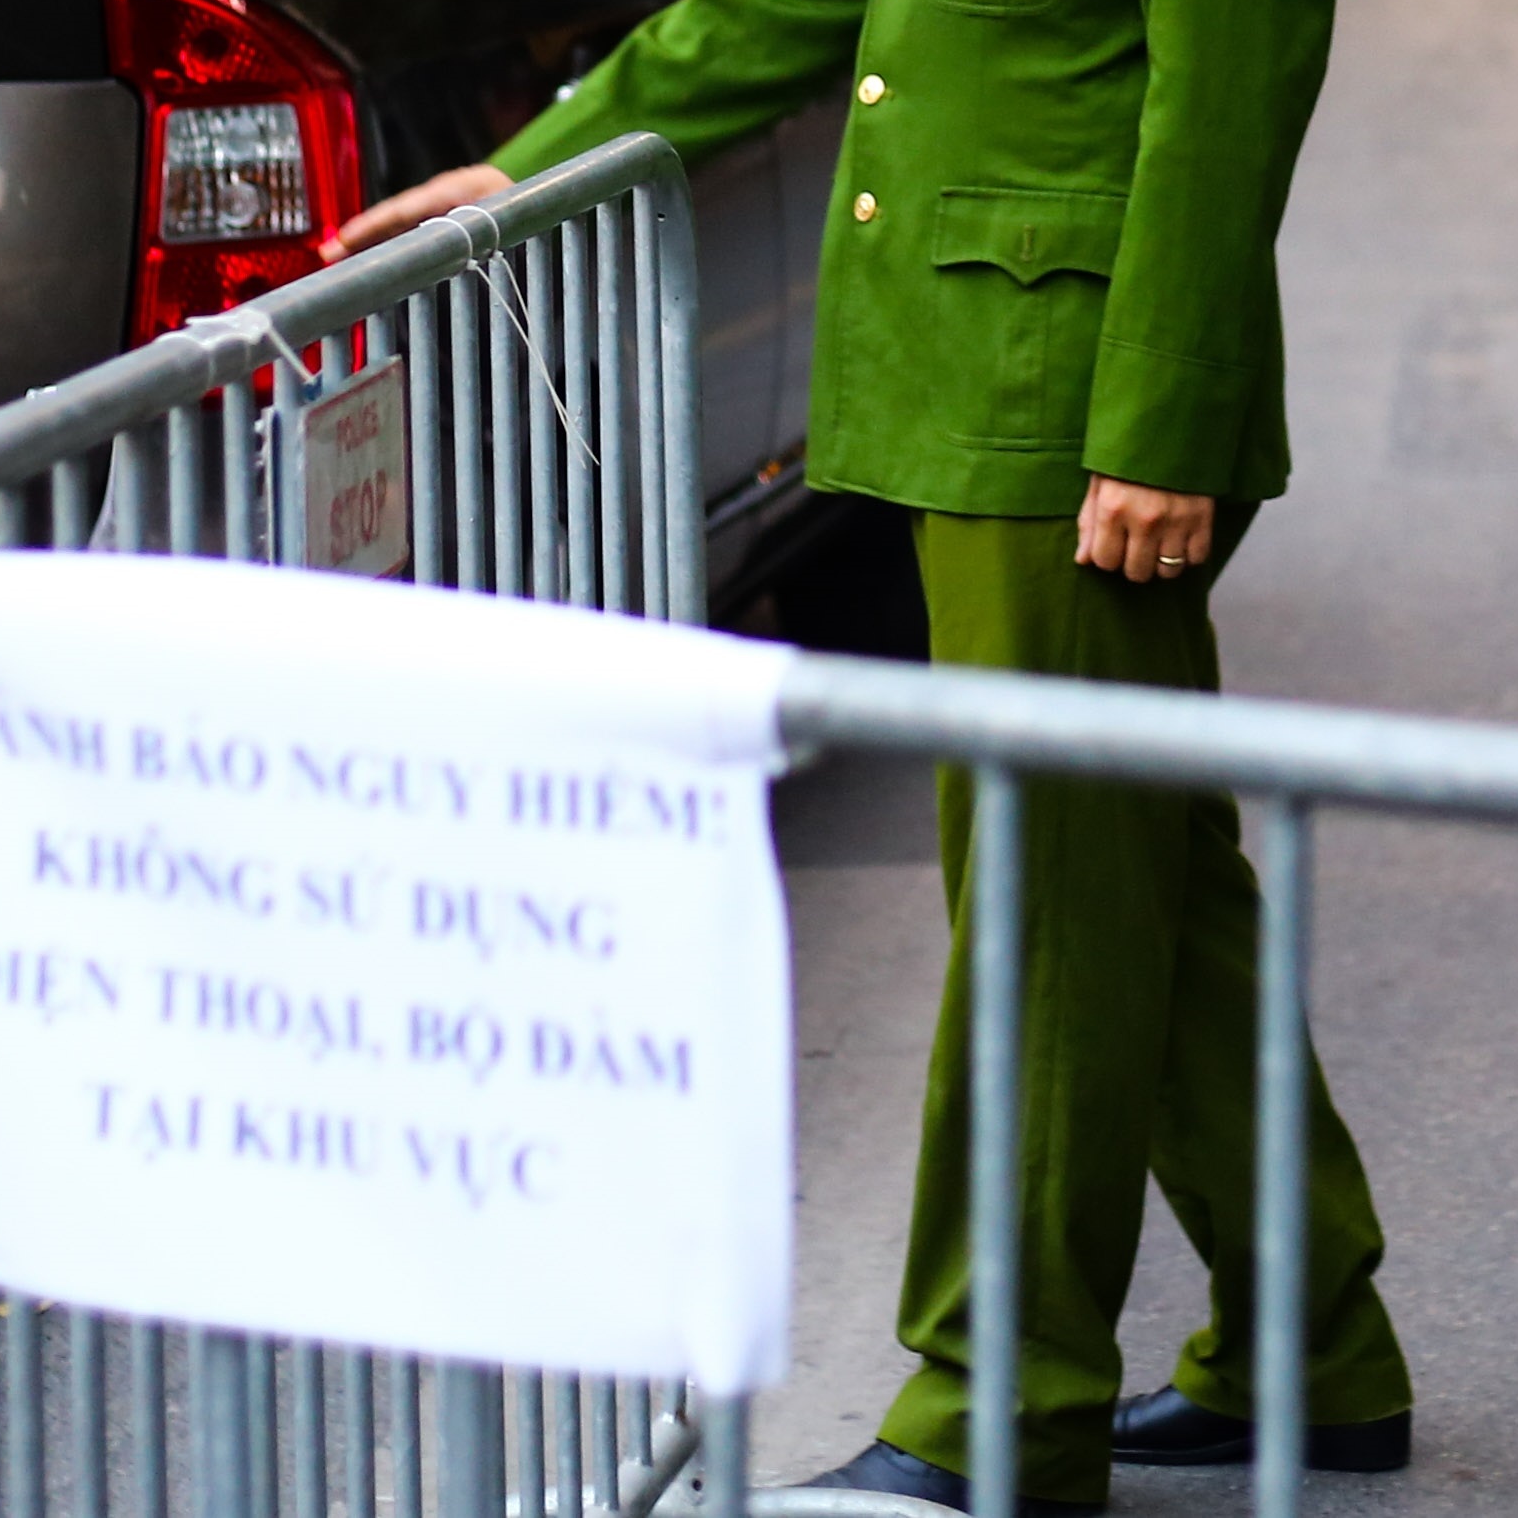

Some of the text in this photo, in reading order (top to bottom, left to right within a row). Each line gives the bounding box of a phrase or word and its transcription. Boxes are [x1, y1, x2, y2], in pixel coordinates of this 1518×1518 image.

[329, 467, 388, 566] STOP
[290, 740, 482, 820] NGUY
[33, 823, 276, 918] KHÔNG
[413, 880, 616, 961] DỤNG
[85, 1082, 560, 1209] TẠI KHU VỰC
